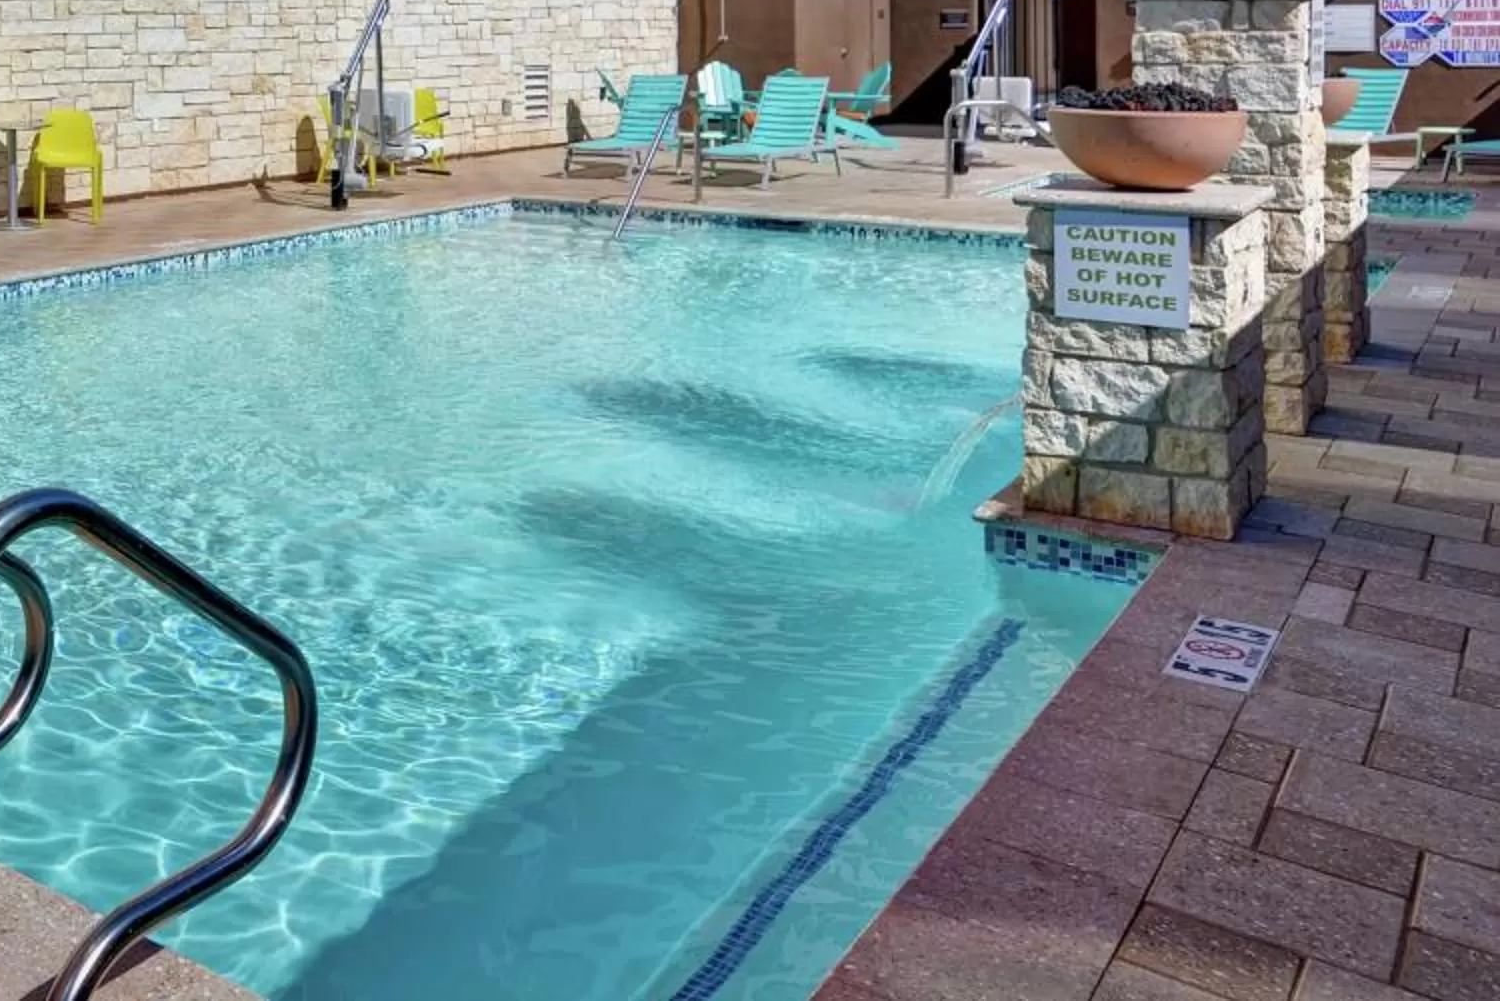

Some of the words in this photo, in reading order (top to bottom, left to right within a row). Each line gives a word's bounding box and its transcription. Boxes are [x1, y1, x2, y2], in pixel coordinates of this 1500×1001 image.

[1382, 38, 1432, 52] CAPACITY
[1065, 226, 1177, 247] CAUTION
[1071, 246, 1173, 268] BEWARE
[1077, 268, 1108, 284] OF
[1116, 271, 1167, 289] HOT
[1067, 288, 1178, 311] SURFACE
